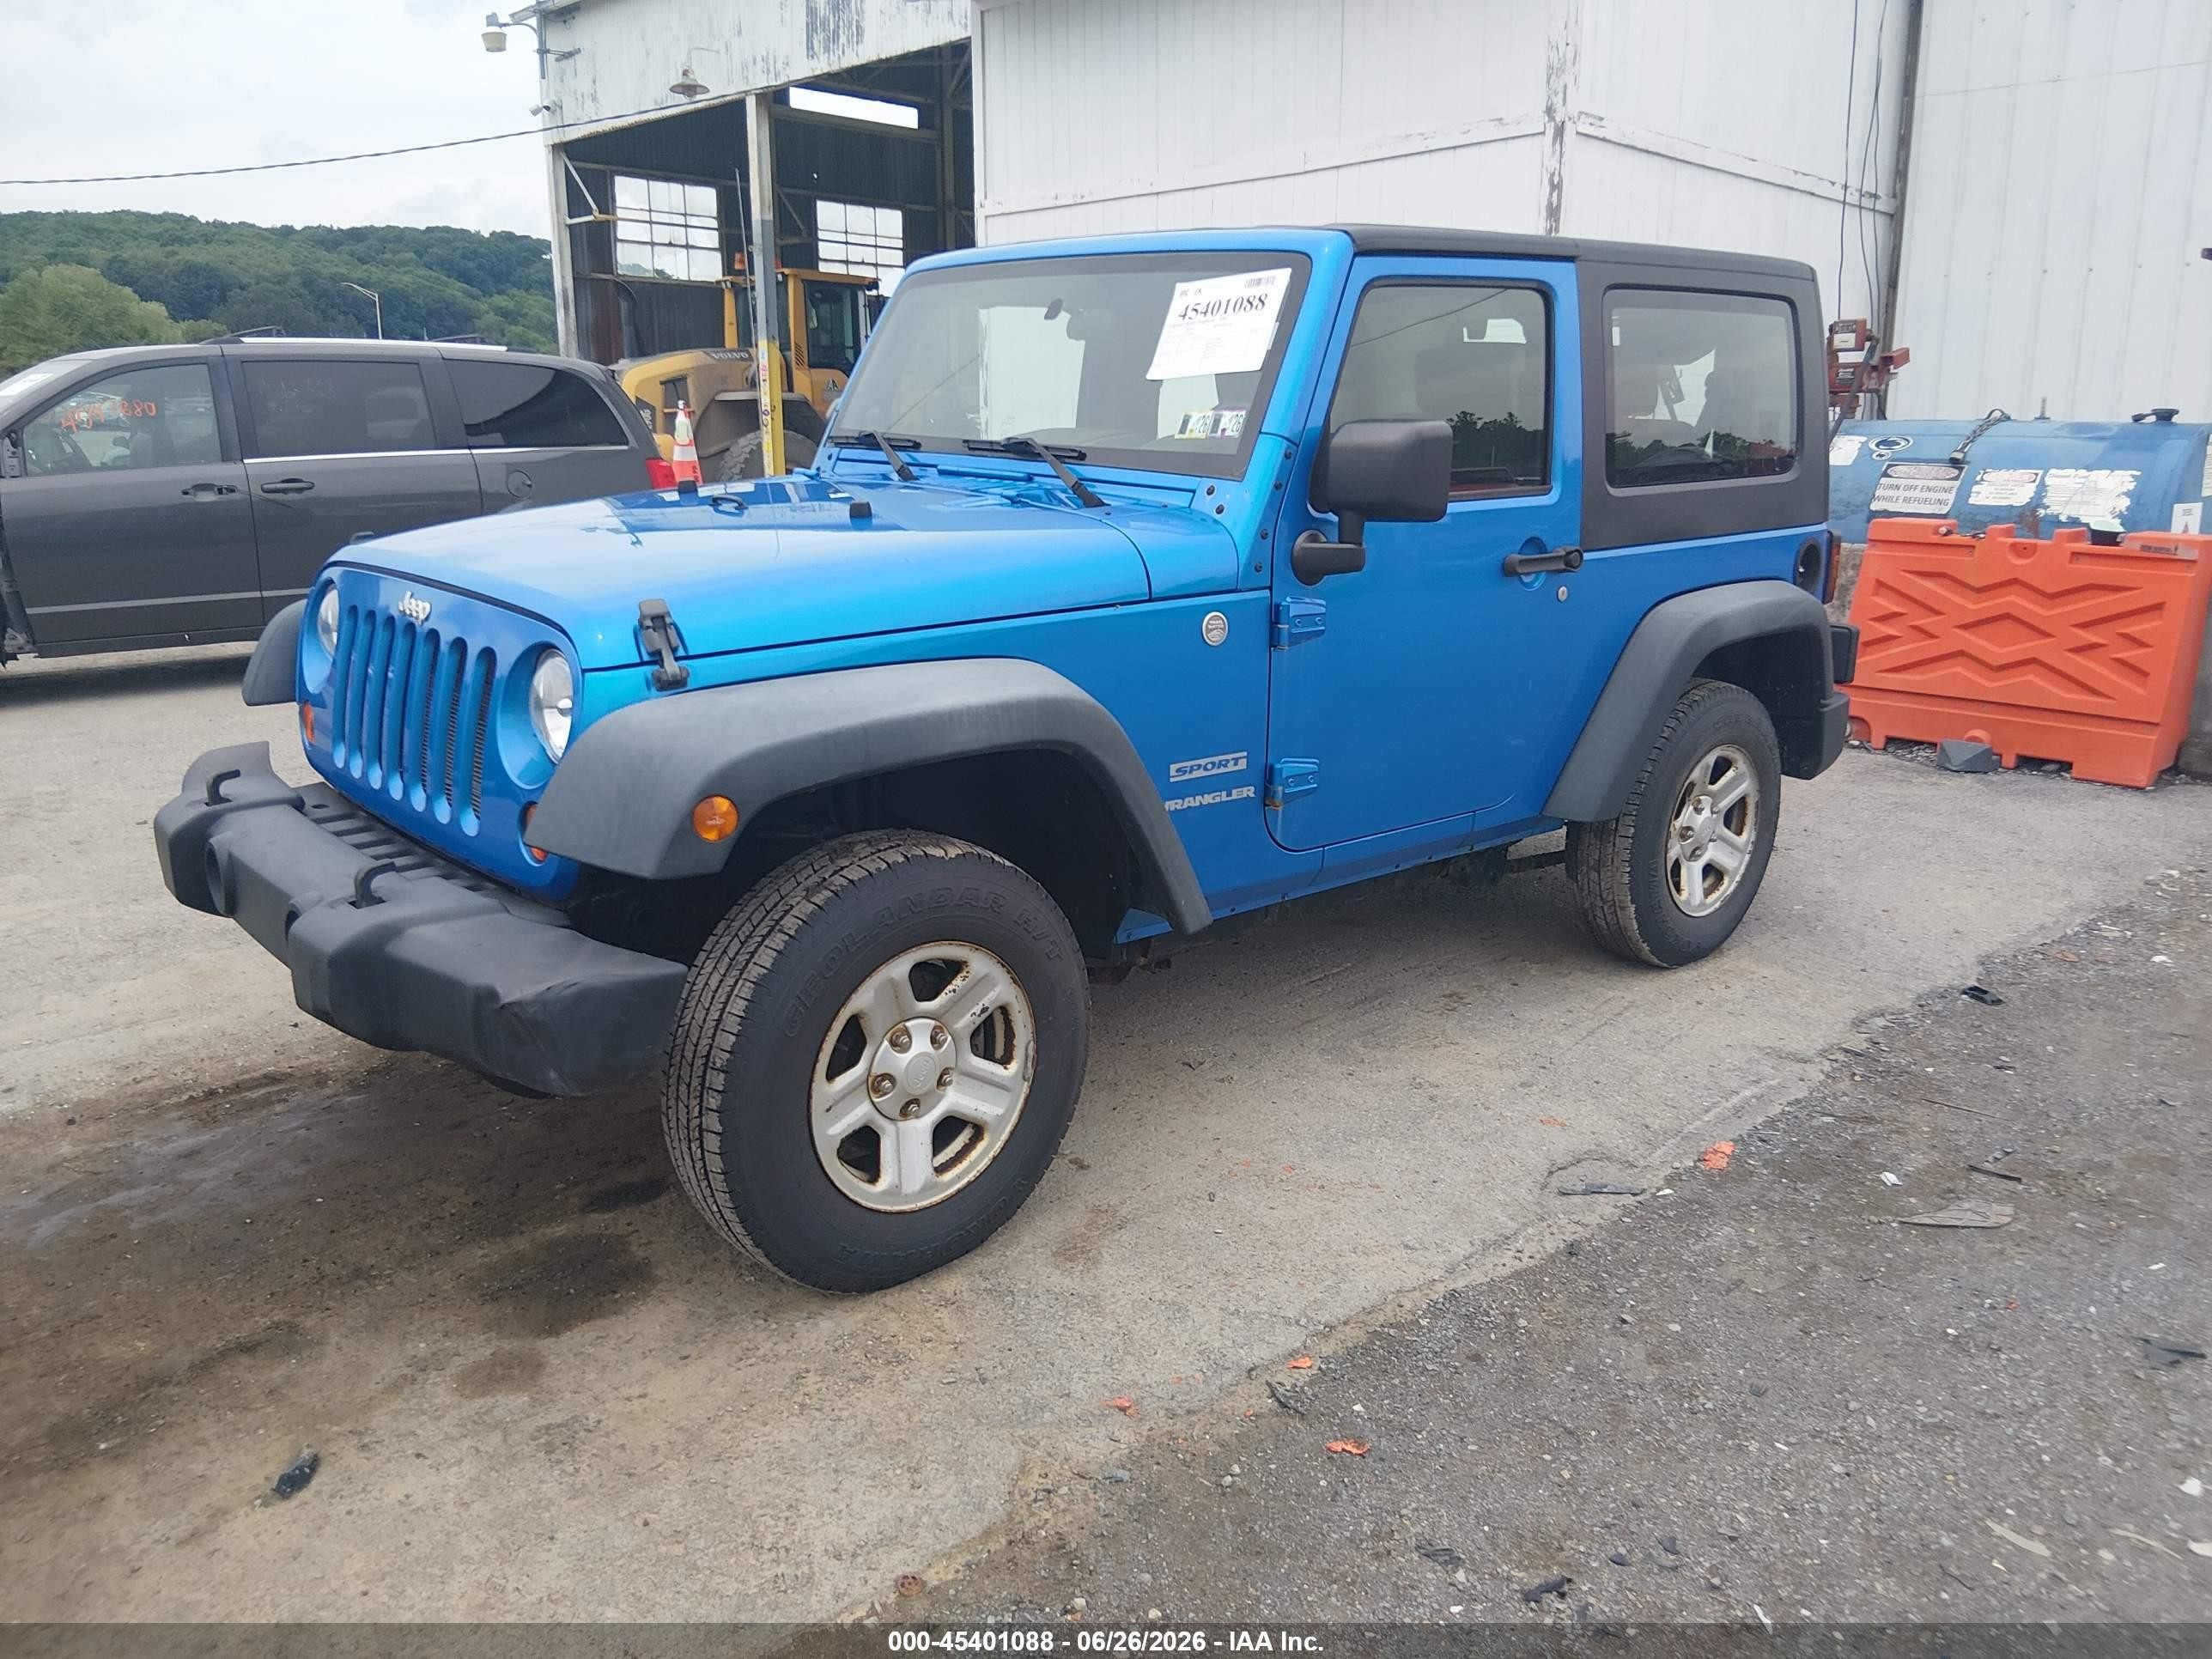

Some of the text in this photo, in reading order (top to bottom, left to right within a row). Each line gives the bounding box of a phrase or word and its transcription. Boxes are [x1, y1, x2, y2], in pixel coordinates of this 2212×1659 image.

[1178, 293, 1268, 320] 45401088
[1878, 483, 1901, 491] TURN
[1920, 485, 1955, 494] ENGINE
[1902, 496, 1951, 507] REFUELING
[398, 591, 431, 625] Jeep
[1175, 757, 1243, 776] SPORT
